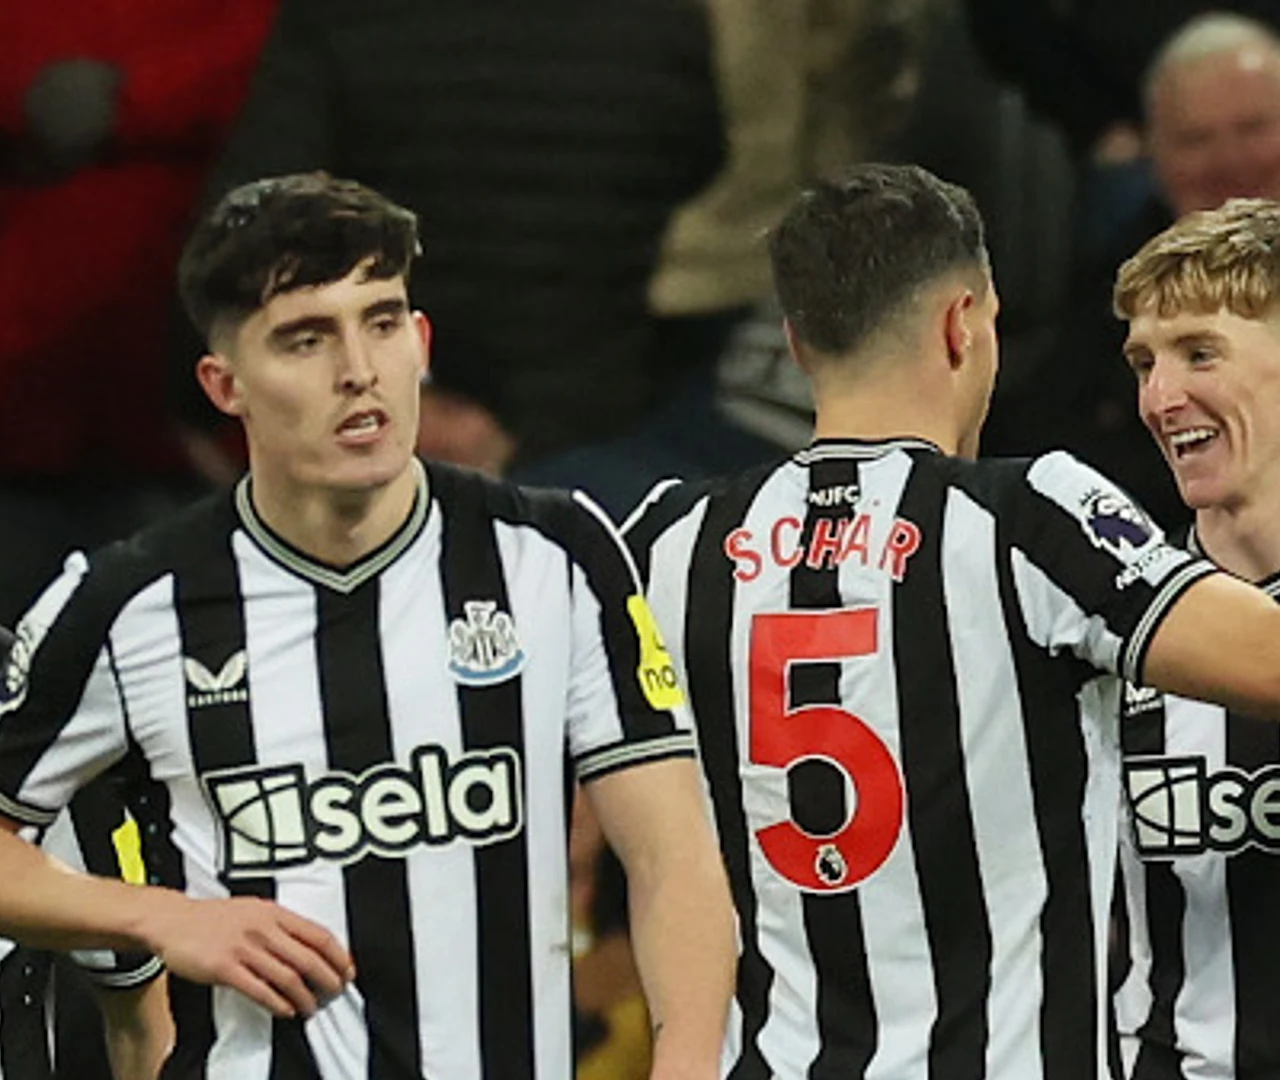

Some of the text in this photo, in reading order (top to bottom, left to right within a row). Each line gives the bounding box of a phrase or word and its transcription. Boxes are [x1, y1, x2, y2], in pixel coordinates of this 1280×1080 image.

[809, 485, 860, 506] NUFC
[748, 607, 906, 894] 5
[311, 752, 512, 852] sela
